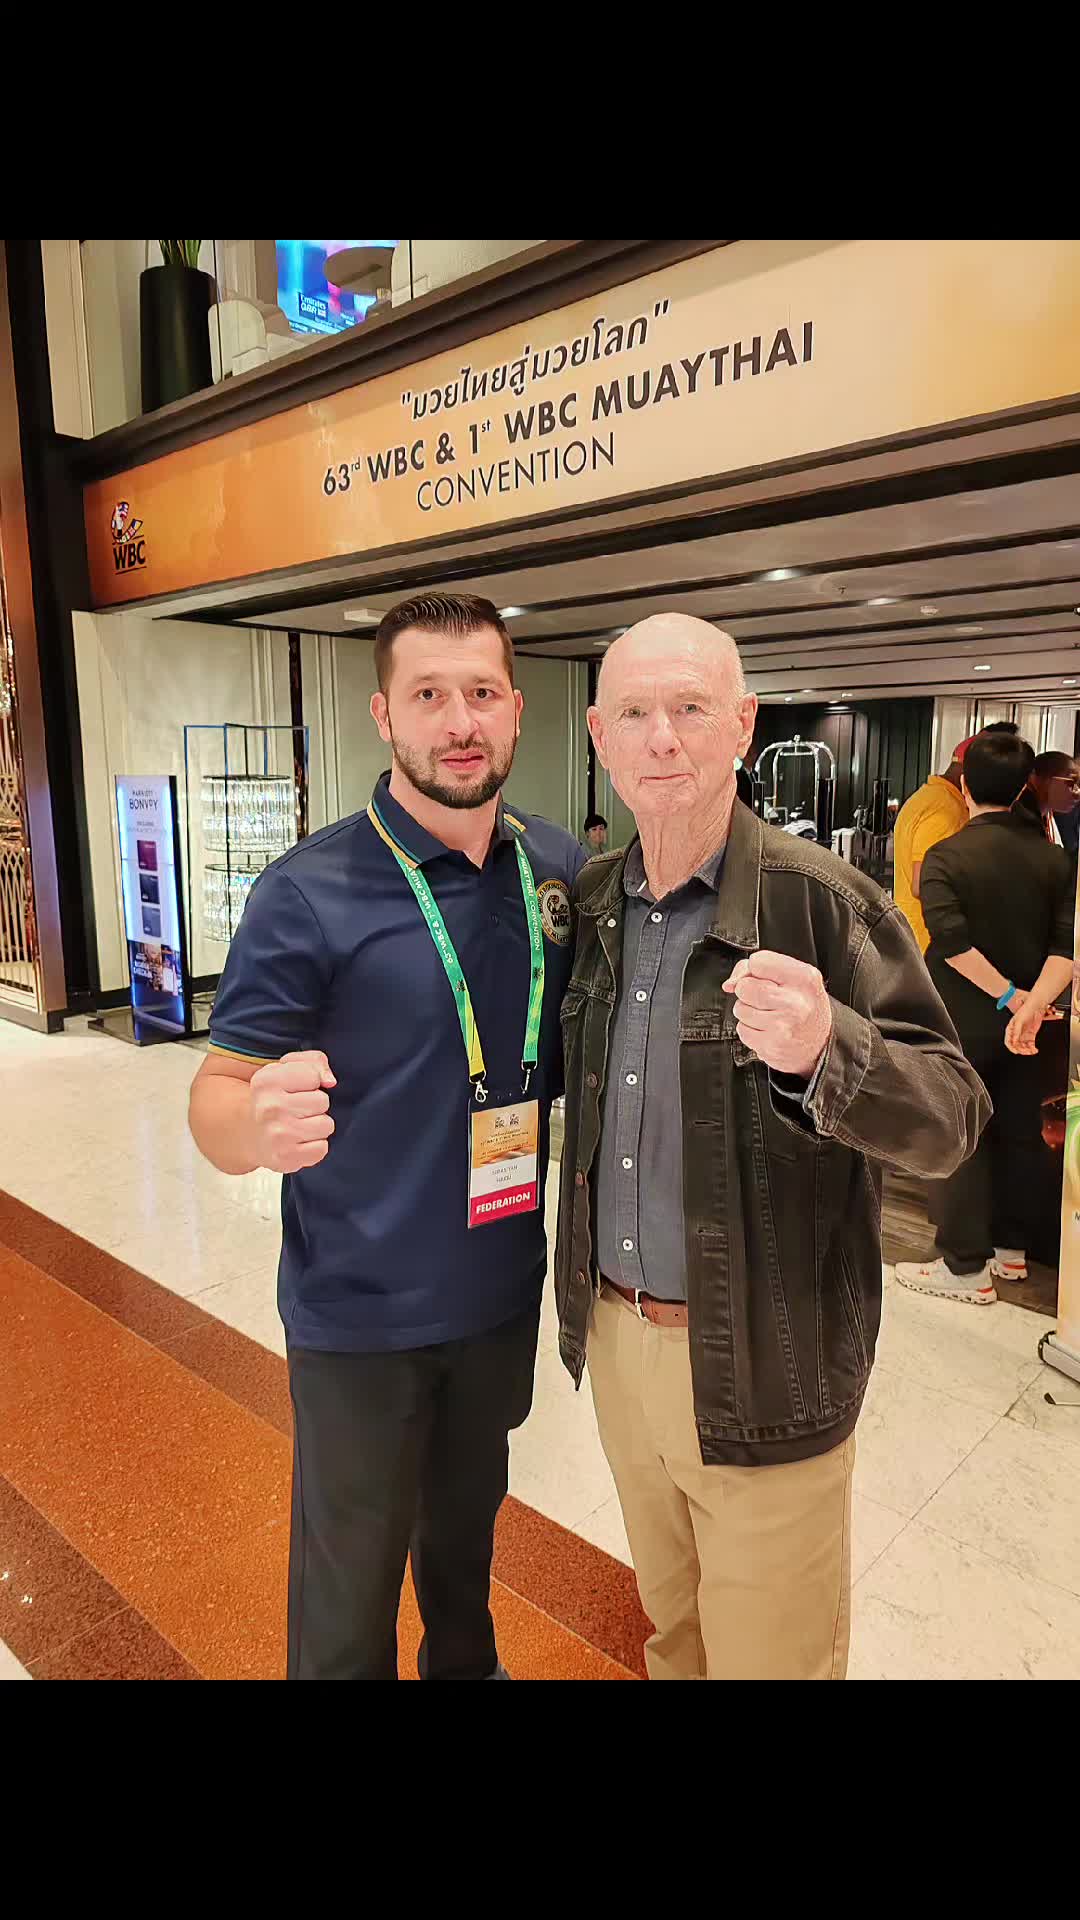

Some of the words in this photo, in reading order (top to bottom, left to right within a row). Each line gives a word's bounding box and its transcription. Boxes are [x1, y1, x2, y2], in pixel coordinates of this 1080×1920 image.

[401, 300, 669, 419] "มวยไทยสู่มวยโลก"
[323, 457, 360, 495] 63rd
[367, 440, 425, 483] WBC
[435, 432, 456, 465] &
[469, 419, 491, 454] 1st
[503, 393, 577, 444] WBC
[592, 321, 813, 421] MUAYTHAI
[417, 432, 614, 511] CONVENTION
[113, 540, 146, 570] WBC
[418, 889, 432, 910] WBC
[520, 857, 534, 897] MUAYTHAI
[529, 900, 541, 951] CONVENTION
[435, 928, 448, 949] WBC
[475, 1191, 531, 1215] FEDERATION
